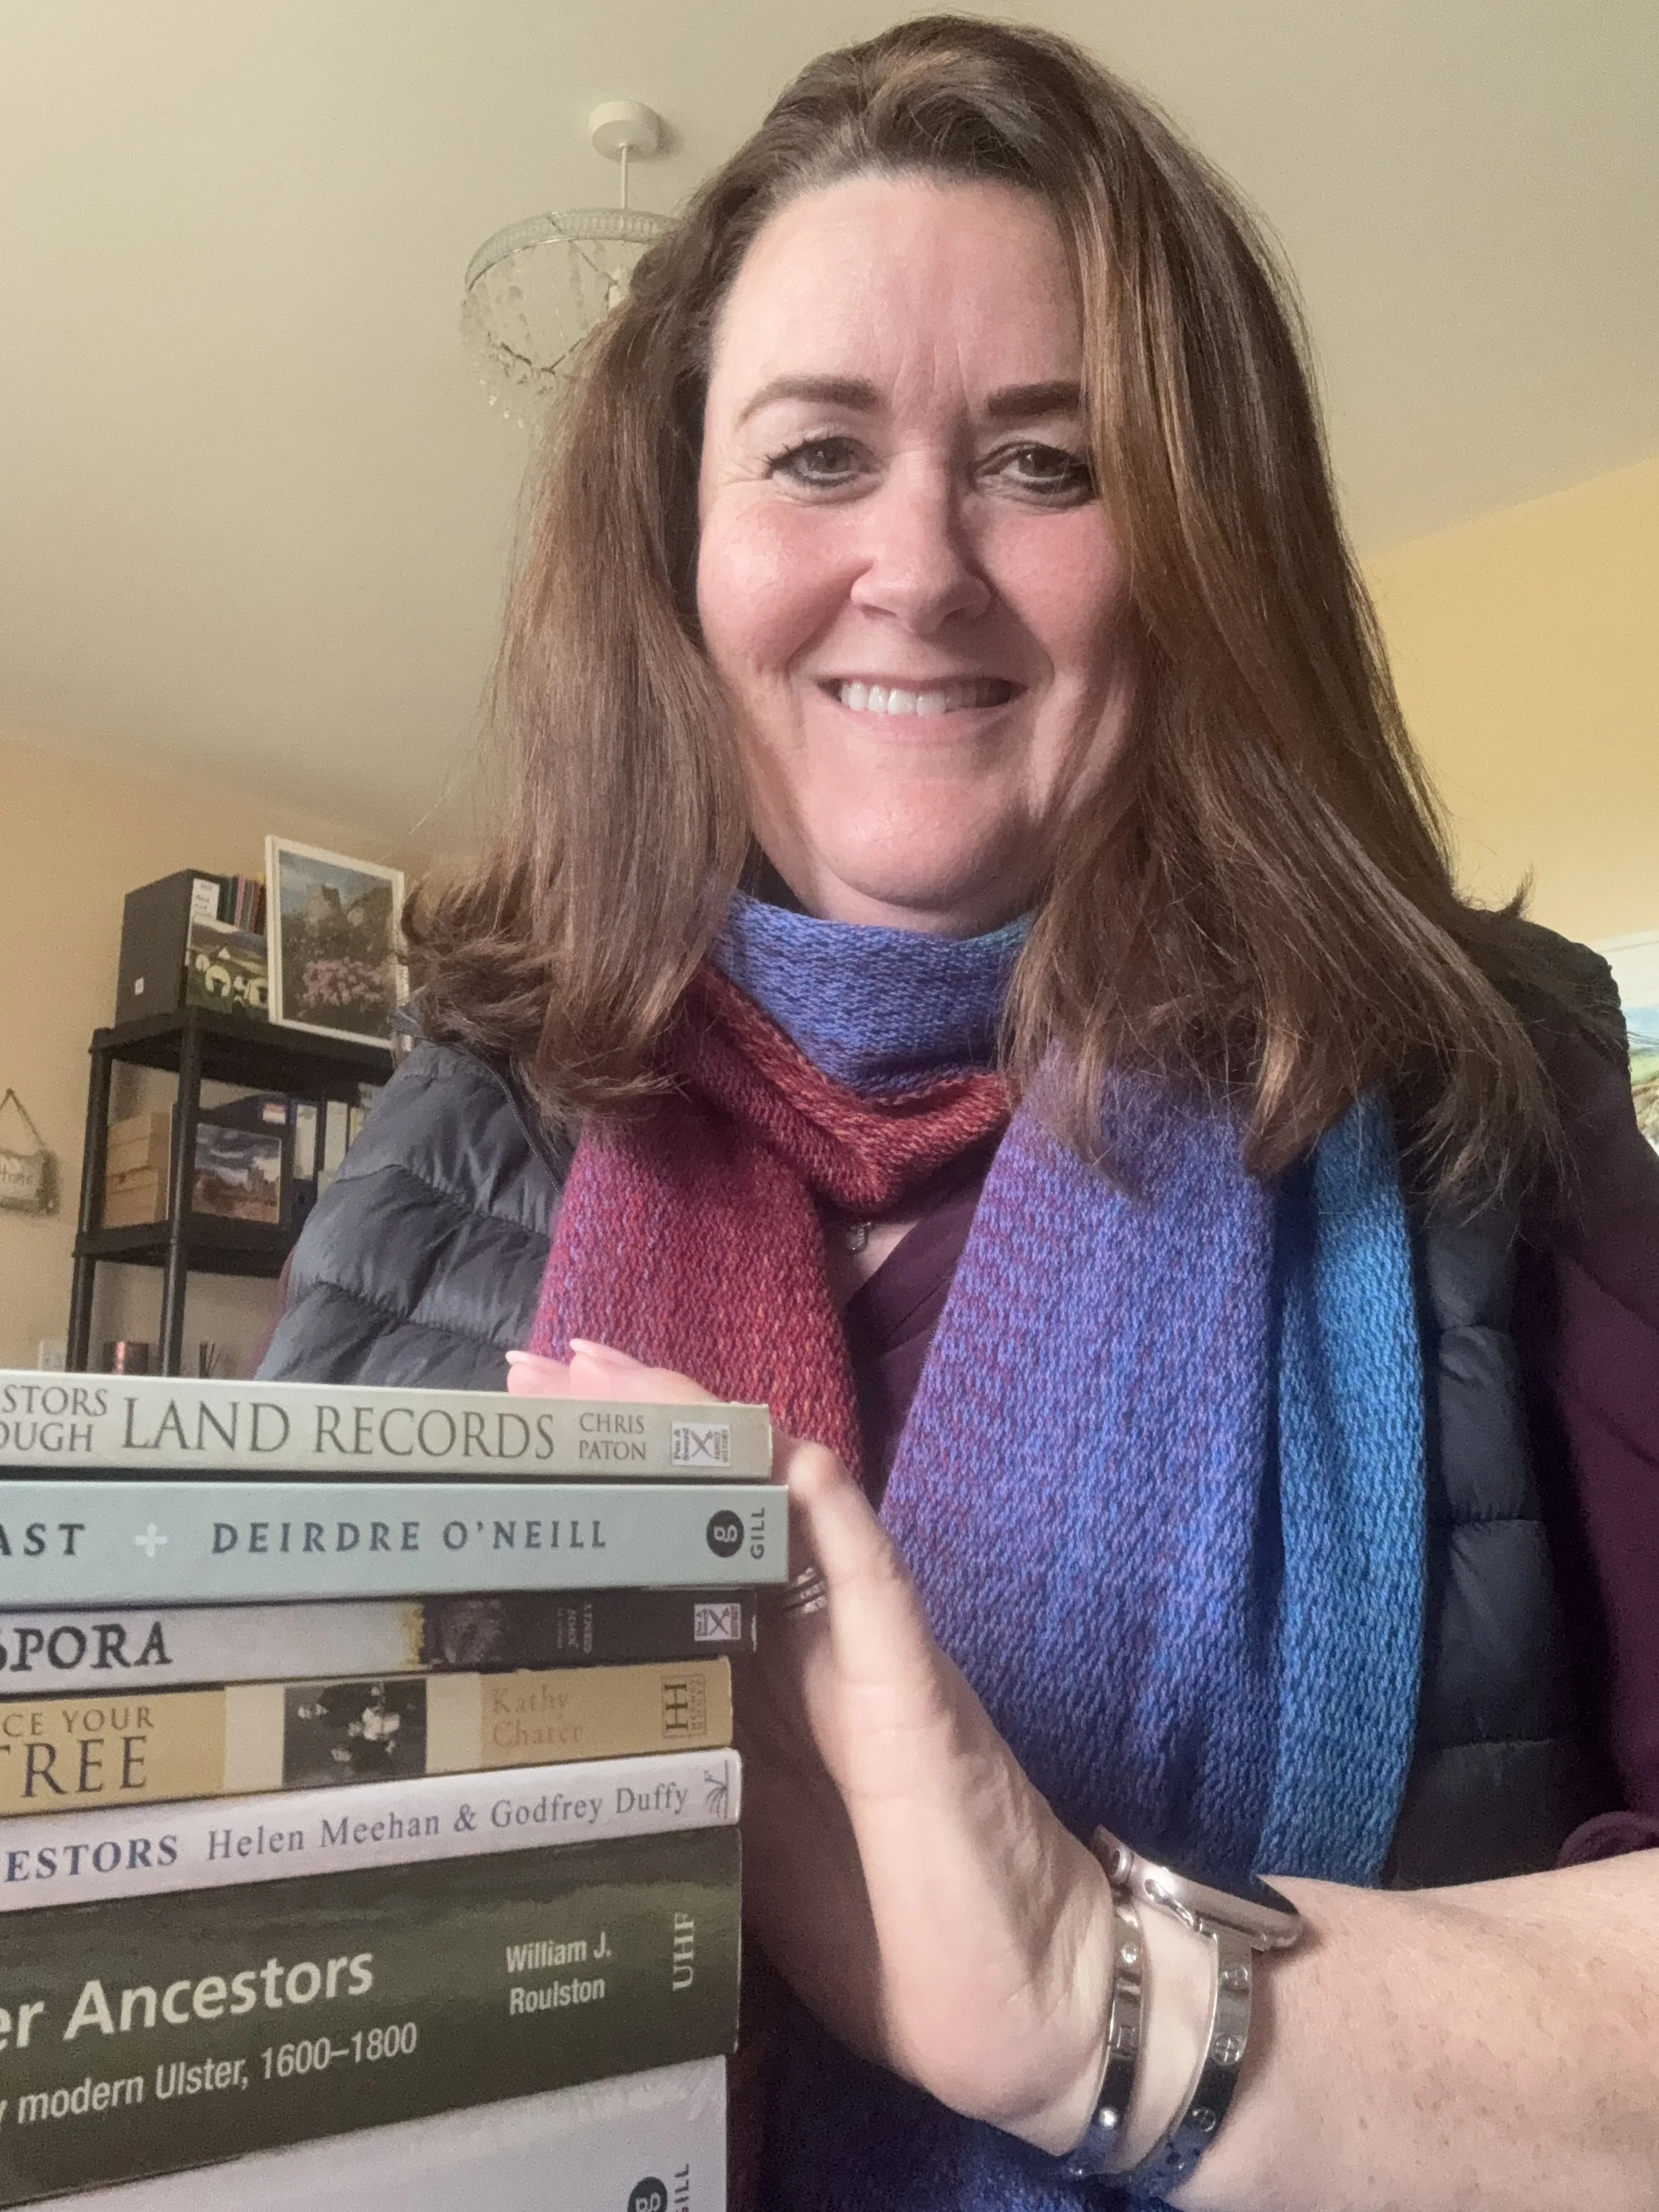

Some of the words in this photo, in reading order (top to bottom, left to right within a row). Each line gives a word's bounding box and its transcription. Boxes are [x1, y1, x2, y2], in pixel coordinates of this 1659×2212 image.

[1, 1383, 109, 1417] STORS
[122, 1397, 290, 1453] LAND
[314, 1405, 554, 1461] RECORDS
[579, 1412, 645, 1434] CHRIS
[579, 1440, 646, 1461] PATON
[213, 1521, 421, 1554] DEIRDRE
[442, 1520, 607, 1550] O'NEILL
[750, 1506, 765, 1559] GILL
[0, 1621, 173, 1672] PORA
[2, 1712, 44, 1738] CE
[62, 1705, 155, 1734] YOUR
[491, 1683, 569, 1716] Kathy
[4, 1834, 178, 1883] ESTORS
[208, 1826, 306, 1861] Helen
[319, 1811, 441, 1848] Meehan
[453, 1804, 477, 1833] &
[490, 1793, 604, 1828] Godfrey
[615, 1781, 690, 1816] Duffy
[506, 1939, 588, 1974] William
[593, 1930, 613, 1961] J.
[672, 1911, 695, 1992] UHF
[63, 1952, 374, 2042] Ancestors
[509, 1978, 606, 2016] Roulston
[18, 2075, 144, 2124] modern
[155, 2057, 249, 2100] Ulster,
[260, 2021, 418, 2080] 1600–1800
